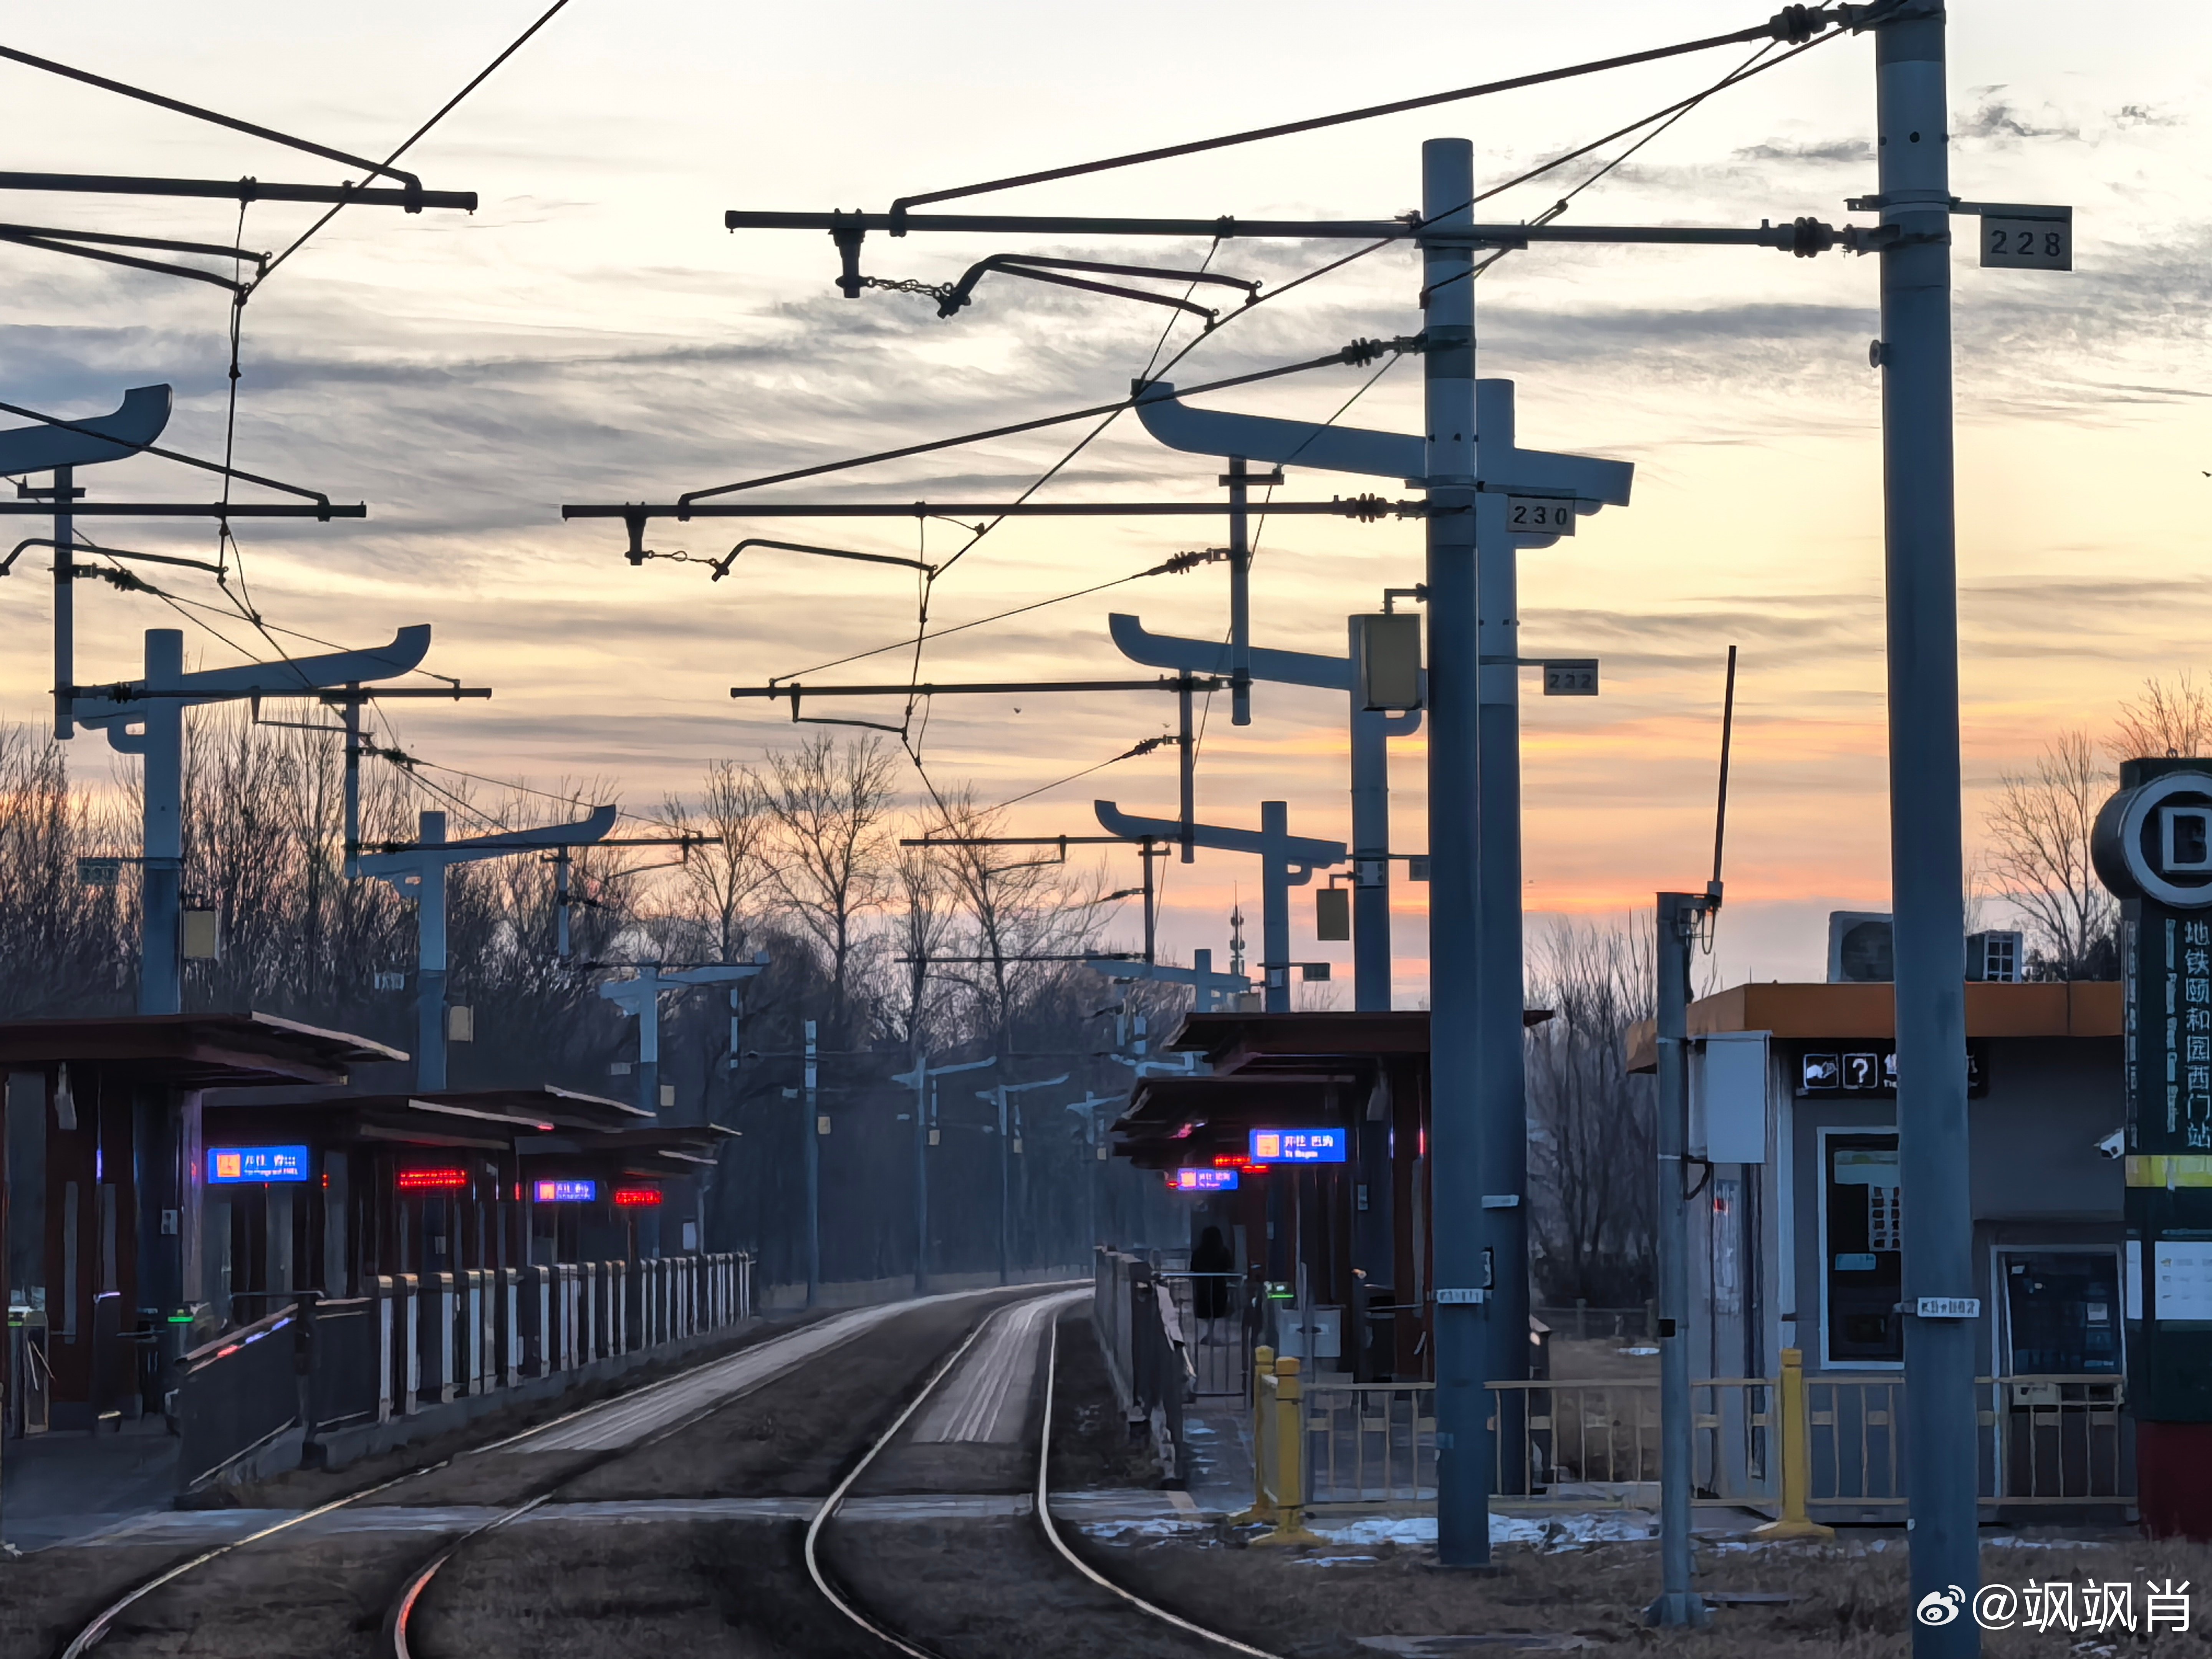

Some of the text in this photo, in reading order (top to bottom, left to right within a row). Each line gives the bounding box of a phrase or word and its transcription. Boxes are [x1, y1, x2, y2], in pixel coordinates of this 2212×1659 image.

[1990, 230, 2061, 257] 228
[1513, 506, 1568, 525] 230
[2184, 919, 2210, 1149] 地铁颐和园西门站
